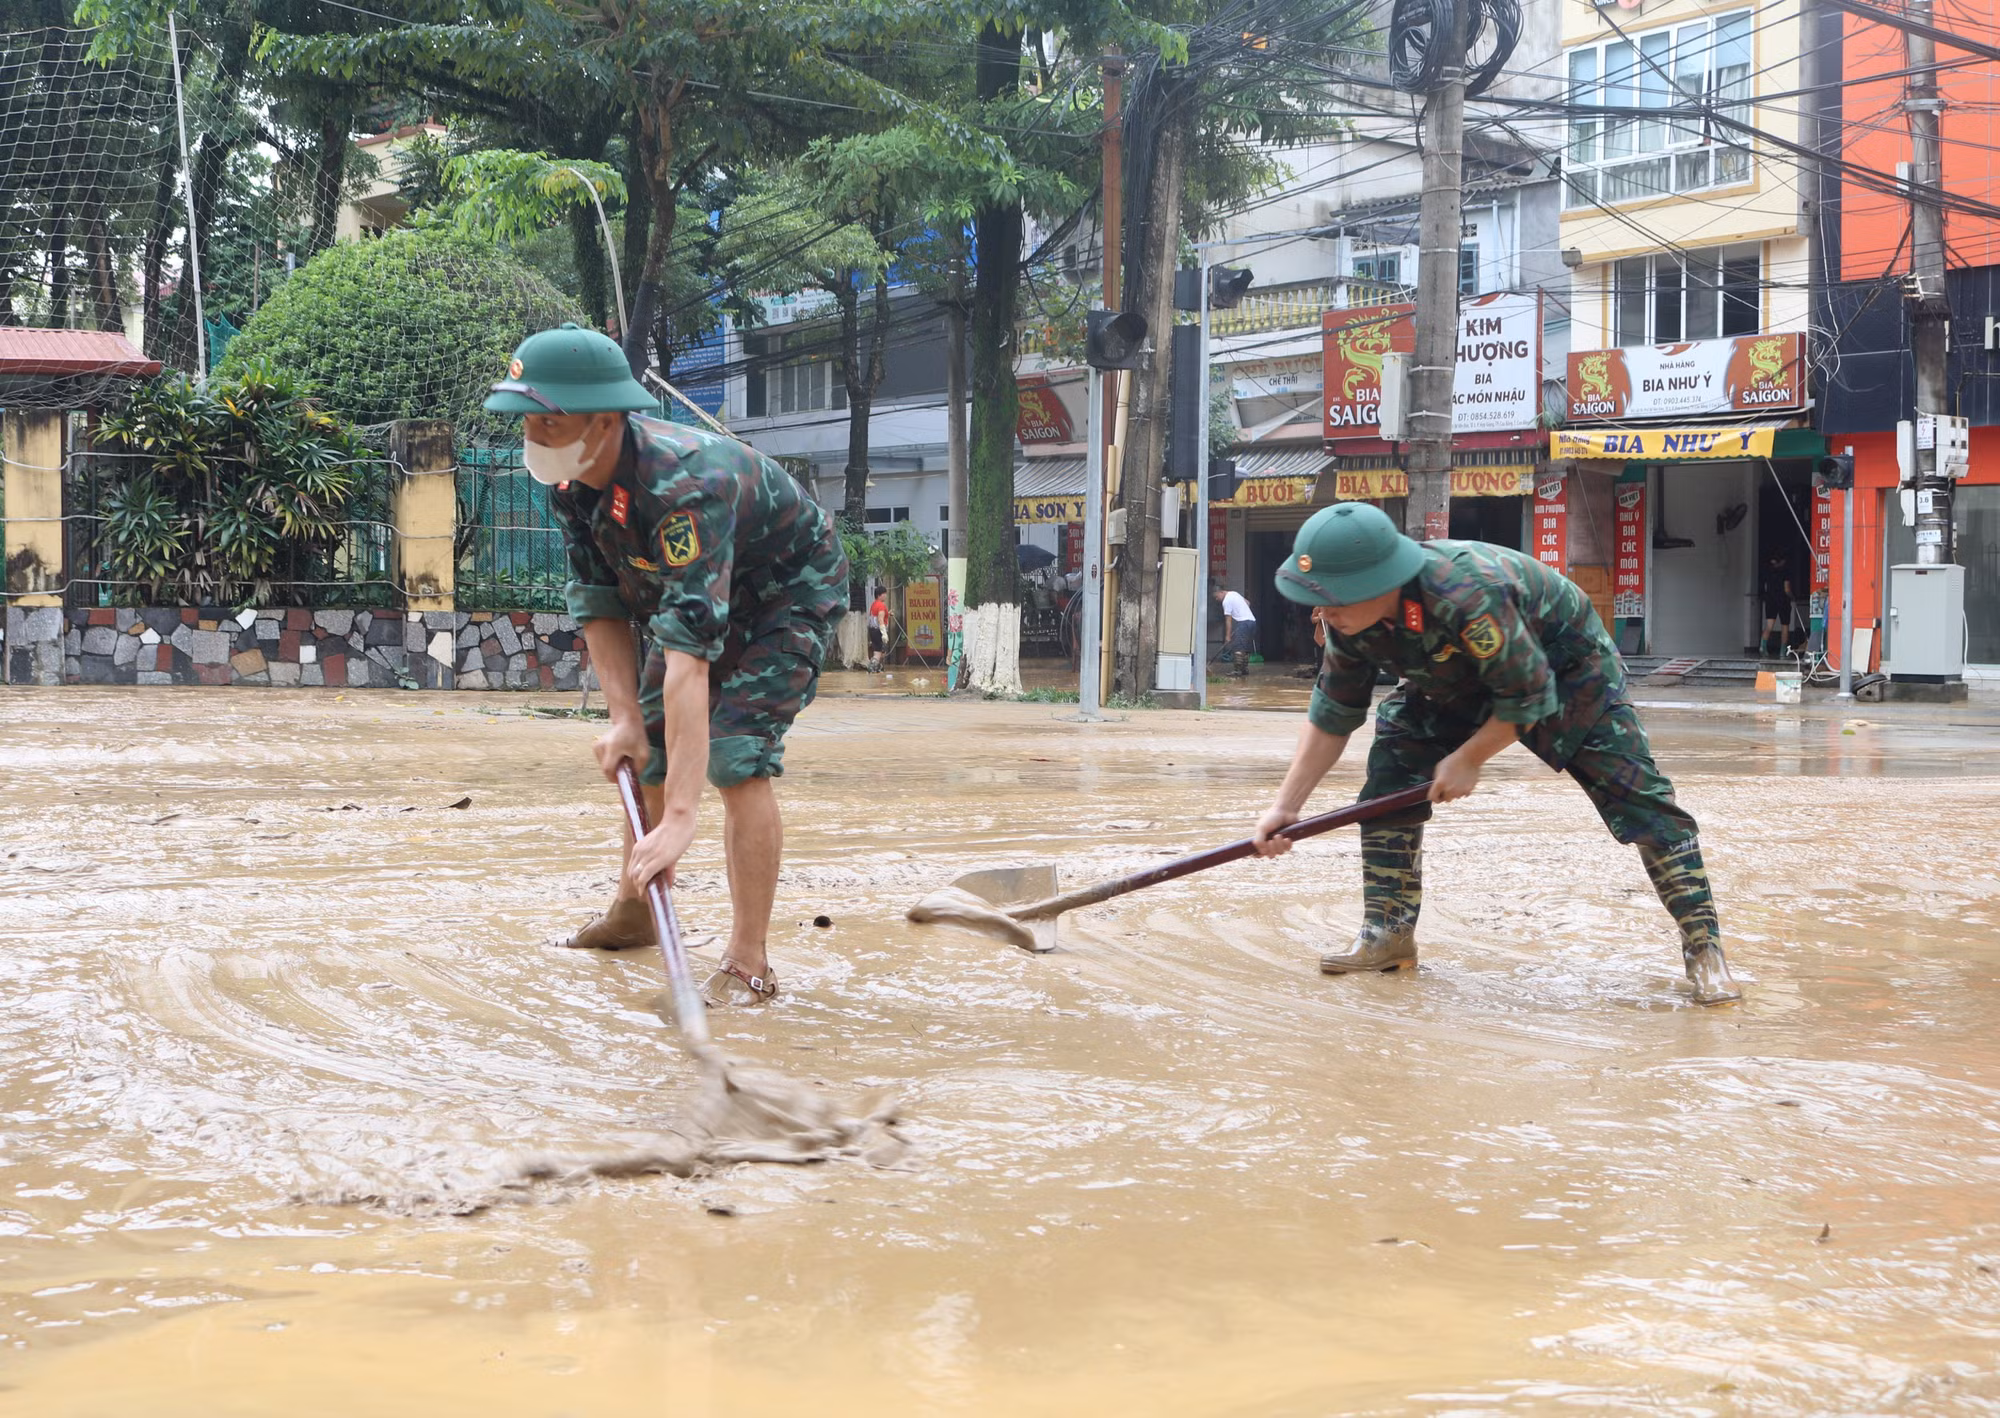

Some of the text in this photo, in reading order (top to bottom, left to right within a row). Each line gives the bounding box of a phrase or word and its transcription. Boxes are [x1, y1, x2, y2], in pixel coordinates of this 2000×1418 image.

[1466, 317, 1502, 337] KIM
[1456, 340, 1529, 367] HƯỢNG
[1659, 360, 1696, 370] NHÀ HÀNG
[1474, 373, 1493, 385] BIA
[1643, 370, 1712, 392] BIA NHƯ Ý
[1759, 381, 1773, 389] BIA
[1356, 388, 1380, 402] BIA
[1452, 387, 1526, 405] ÁC MÓN NHẬU
[1588, 394, 1601, 402] BIA
[1743, 388, 1790, 404] SAIGON
[1573, 401, 1615, 415] SAIGON
[1329, 404, 1381, 427] SAIG
[1470, 411, 1515, 421] 0854.528.619
[1030, 420, 1044, 428] BIA
[1021, 426, 1061, 440] SAIGON
[1603, 435, 1644, 453] BIA
[1662, 432, 1721, 453] NHƯ
[1338, 475, 1371, 494] BIA
[1451, 471, 1517, 496] ƯỢNG
[1014, 504, 1031, 519] IA
[1036, 501, 1066, 518] SƠN
[1619, 509, 1640, 522] NHƯ Ý
[1543, 518, 1556, 529] BIA
[1623, 525, 1636, 536] BIA
[1822, 518, 1830, 529] BI
[1542, 532, 1557, 545] CÁC
[1622, 540, 1637, 553] CÁC
[1540, 548, 1559, 562] MÓN
[1620, 556, 1638, 569] MÓN
[1619, 572, 1639, 587] NHẬU
